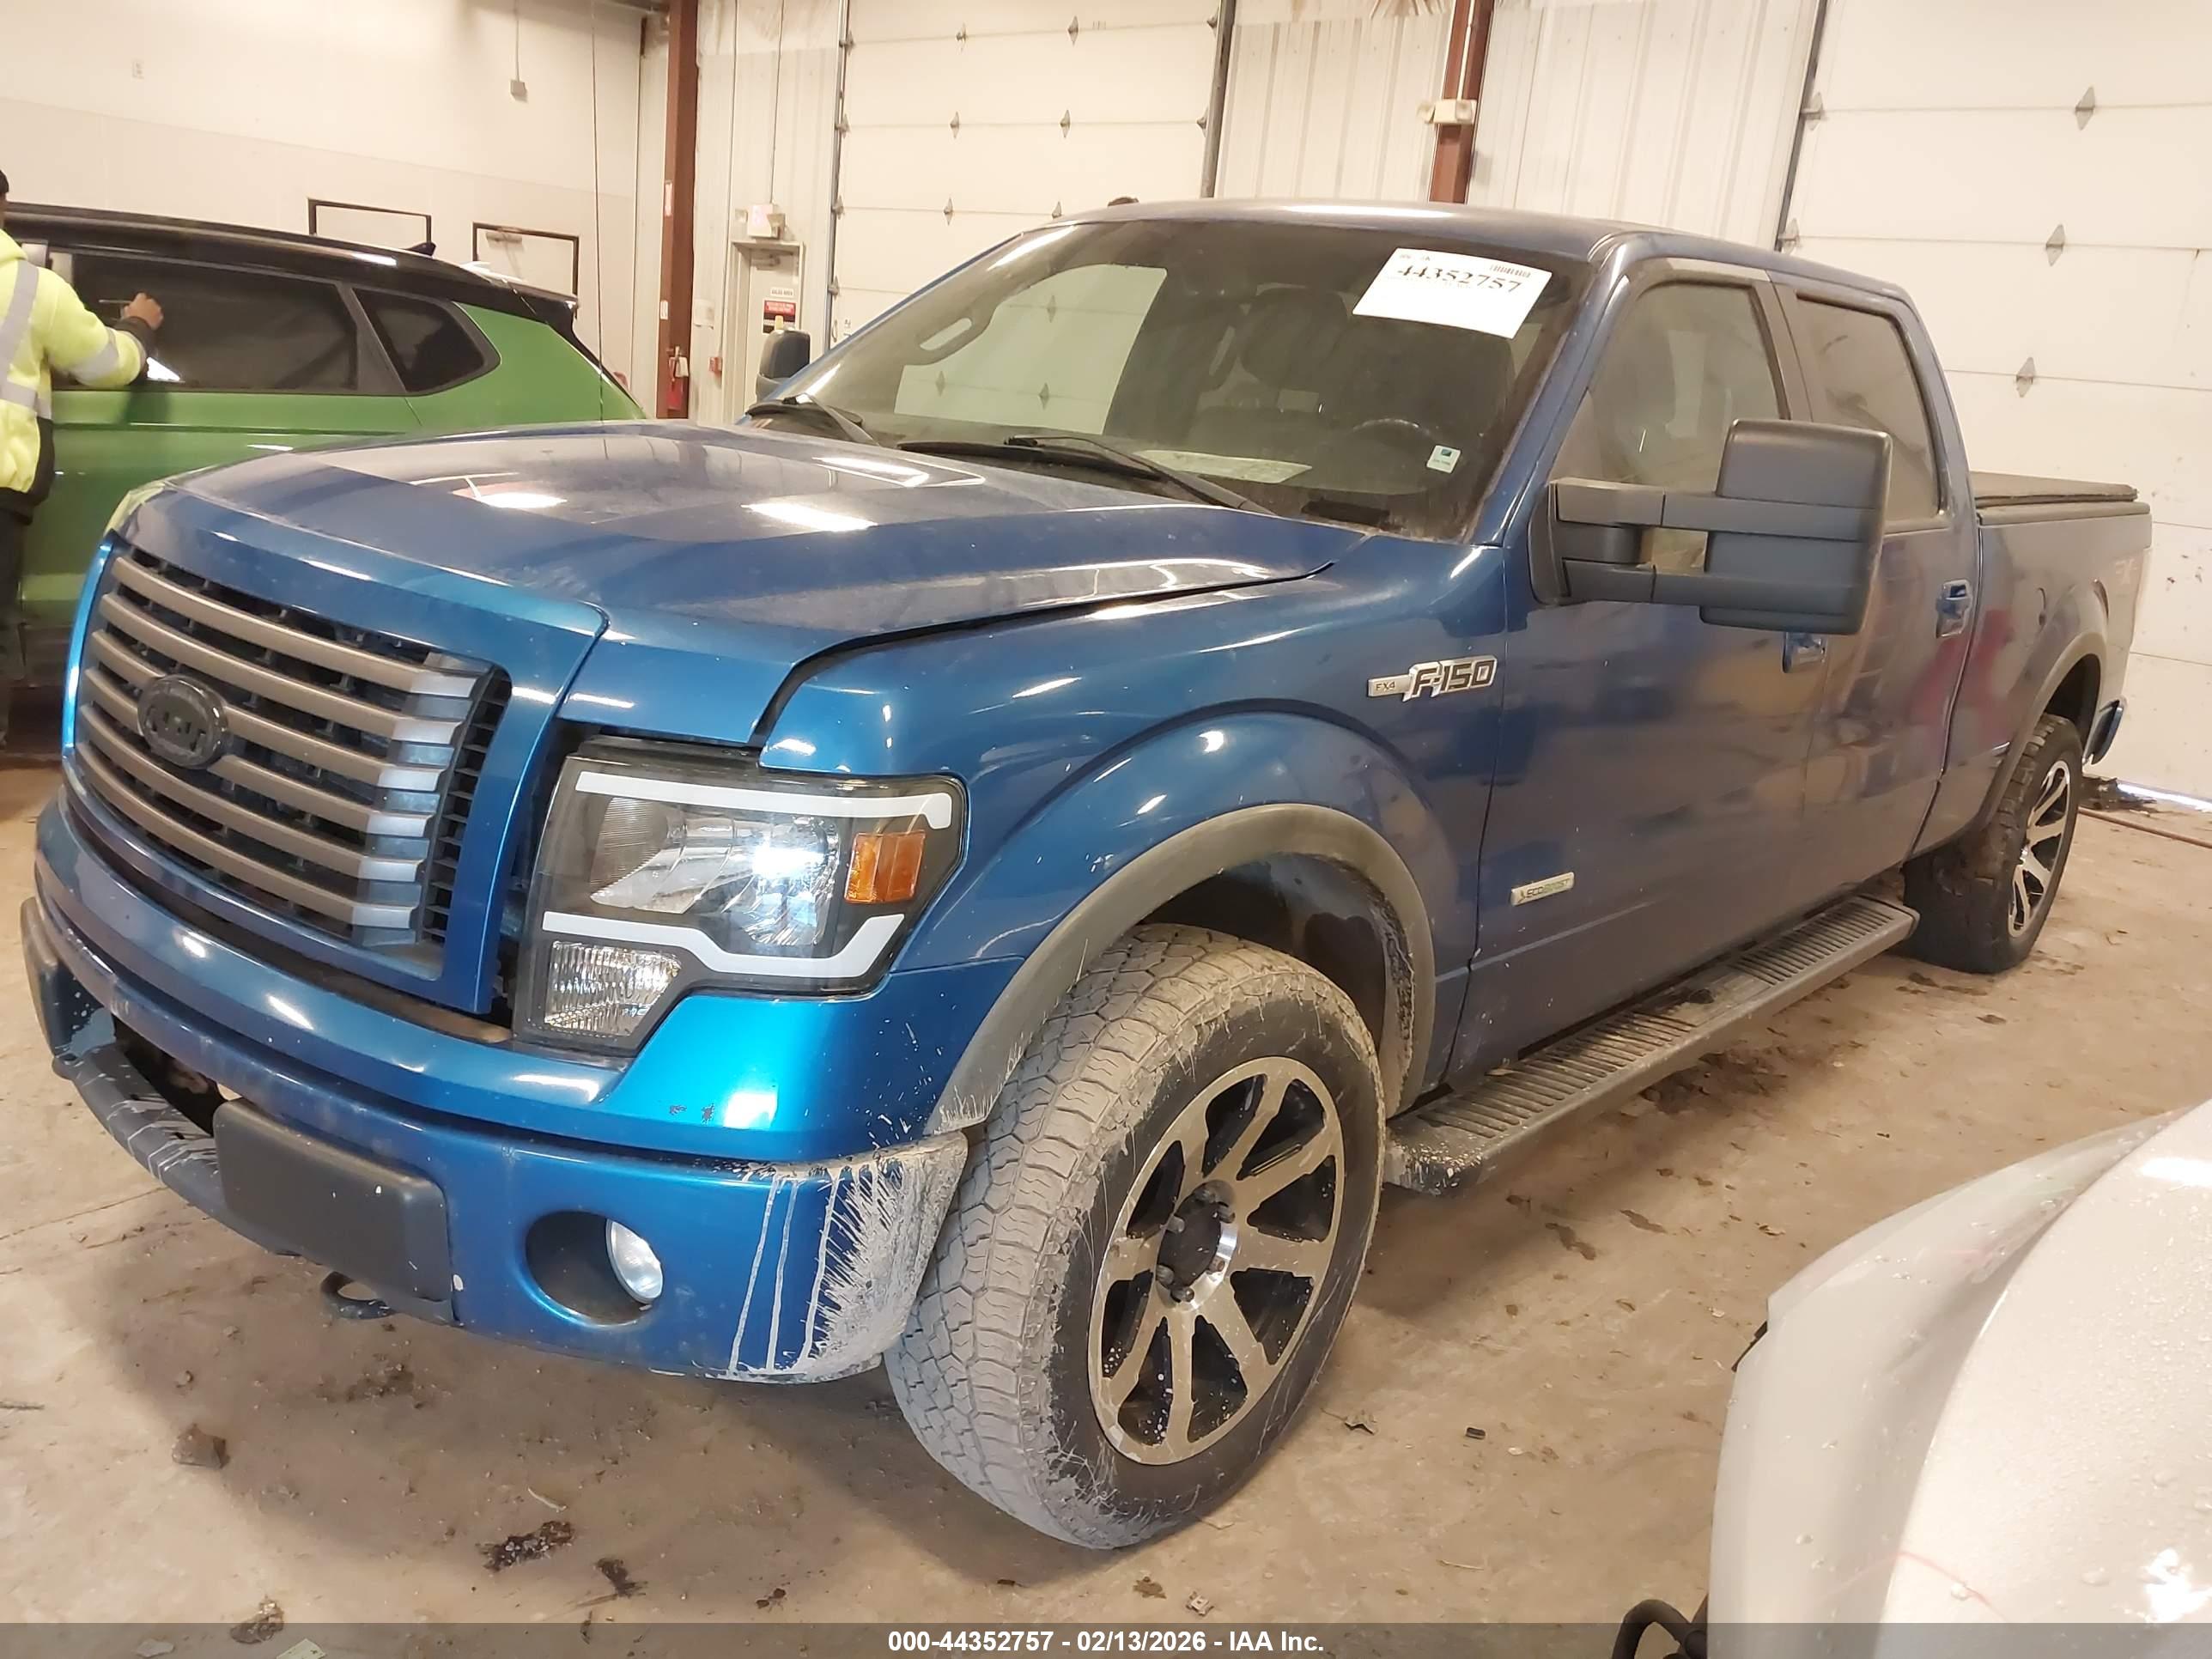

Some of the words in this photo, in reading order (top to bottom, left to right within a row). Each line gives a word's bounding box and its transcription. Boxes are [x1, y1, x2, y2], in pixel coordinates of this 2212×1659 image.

[1397, 264, 1522, 293] 44352757
[1376, 681, 1395, 691] FX4
[1407, 657, 1496, 699] F-150
